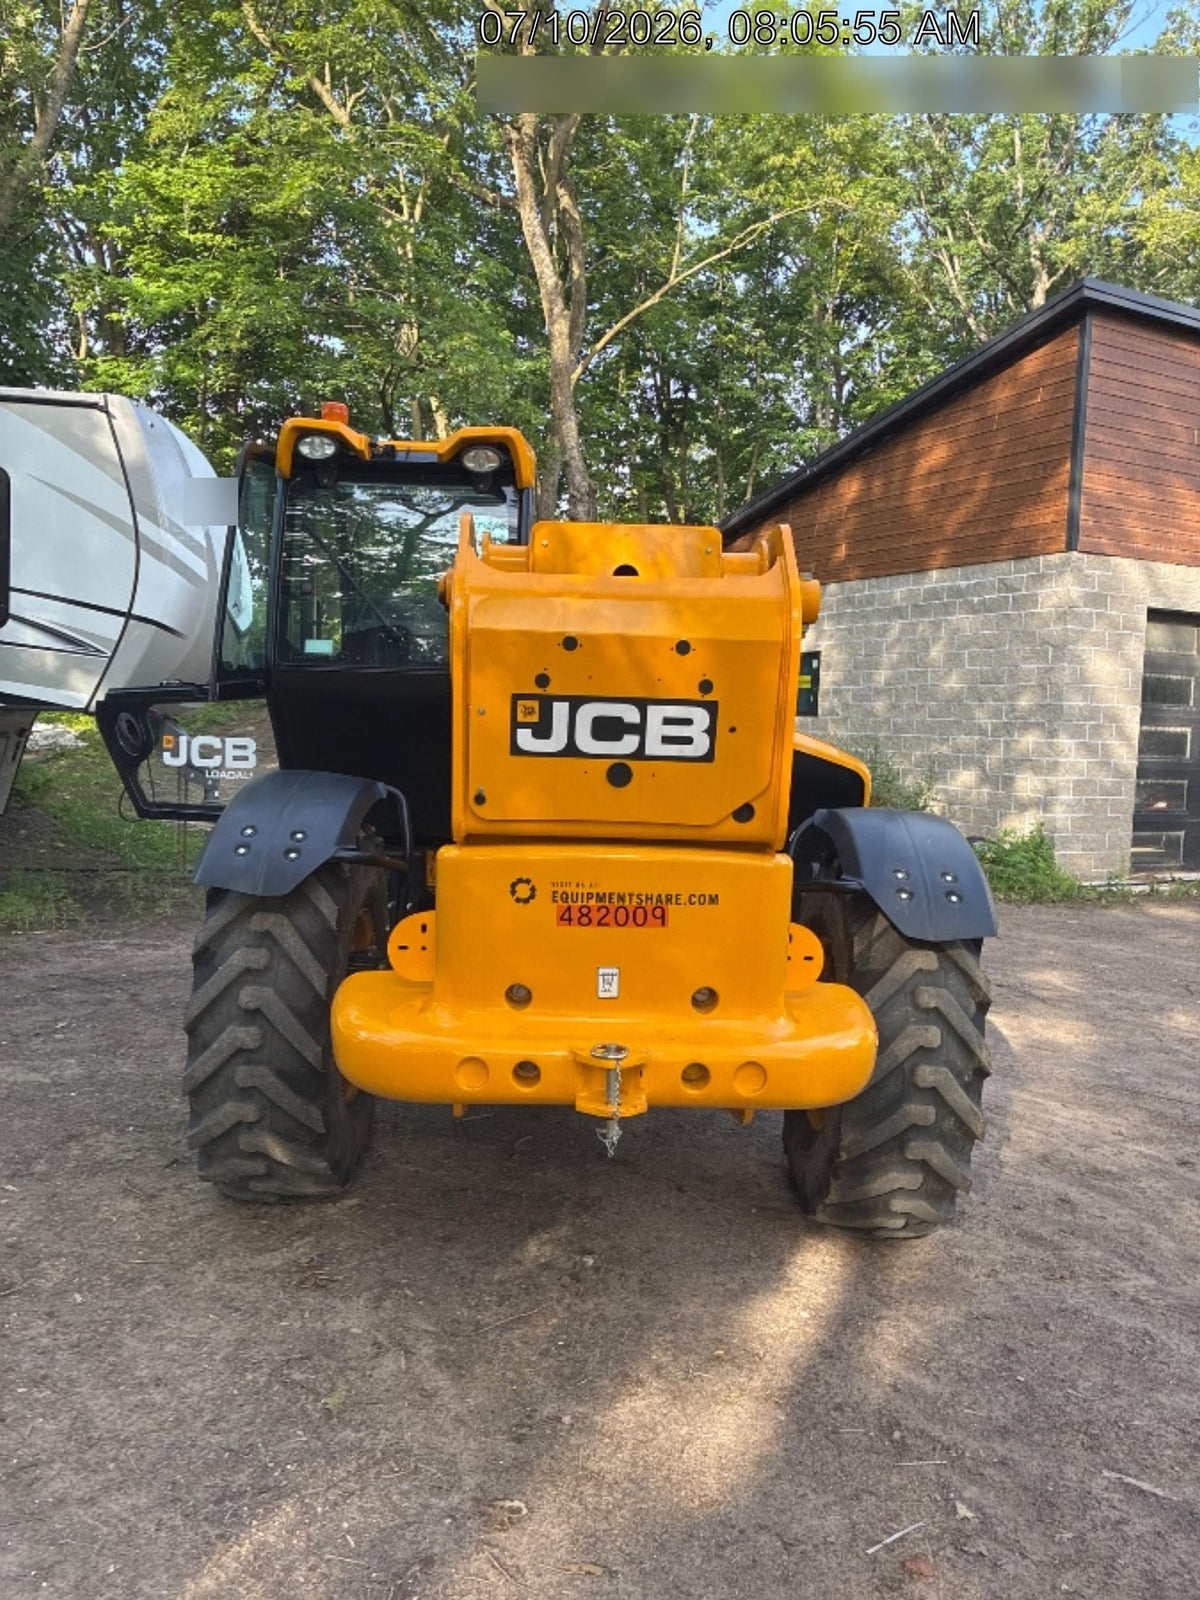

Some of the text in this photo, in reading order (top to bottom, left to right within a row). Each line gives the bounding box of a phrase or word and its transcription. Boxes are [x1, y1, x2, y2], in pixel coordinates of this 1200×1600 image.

[516, 701, 711, 758] JCB
[162, 735, 257, 769] JCB
[551, 890, 719, 906] EQUIPMENTSHARE.COM
[559, 905, 666, 927] 482009
